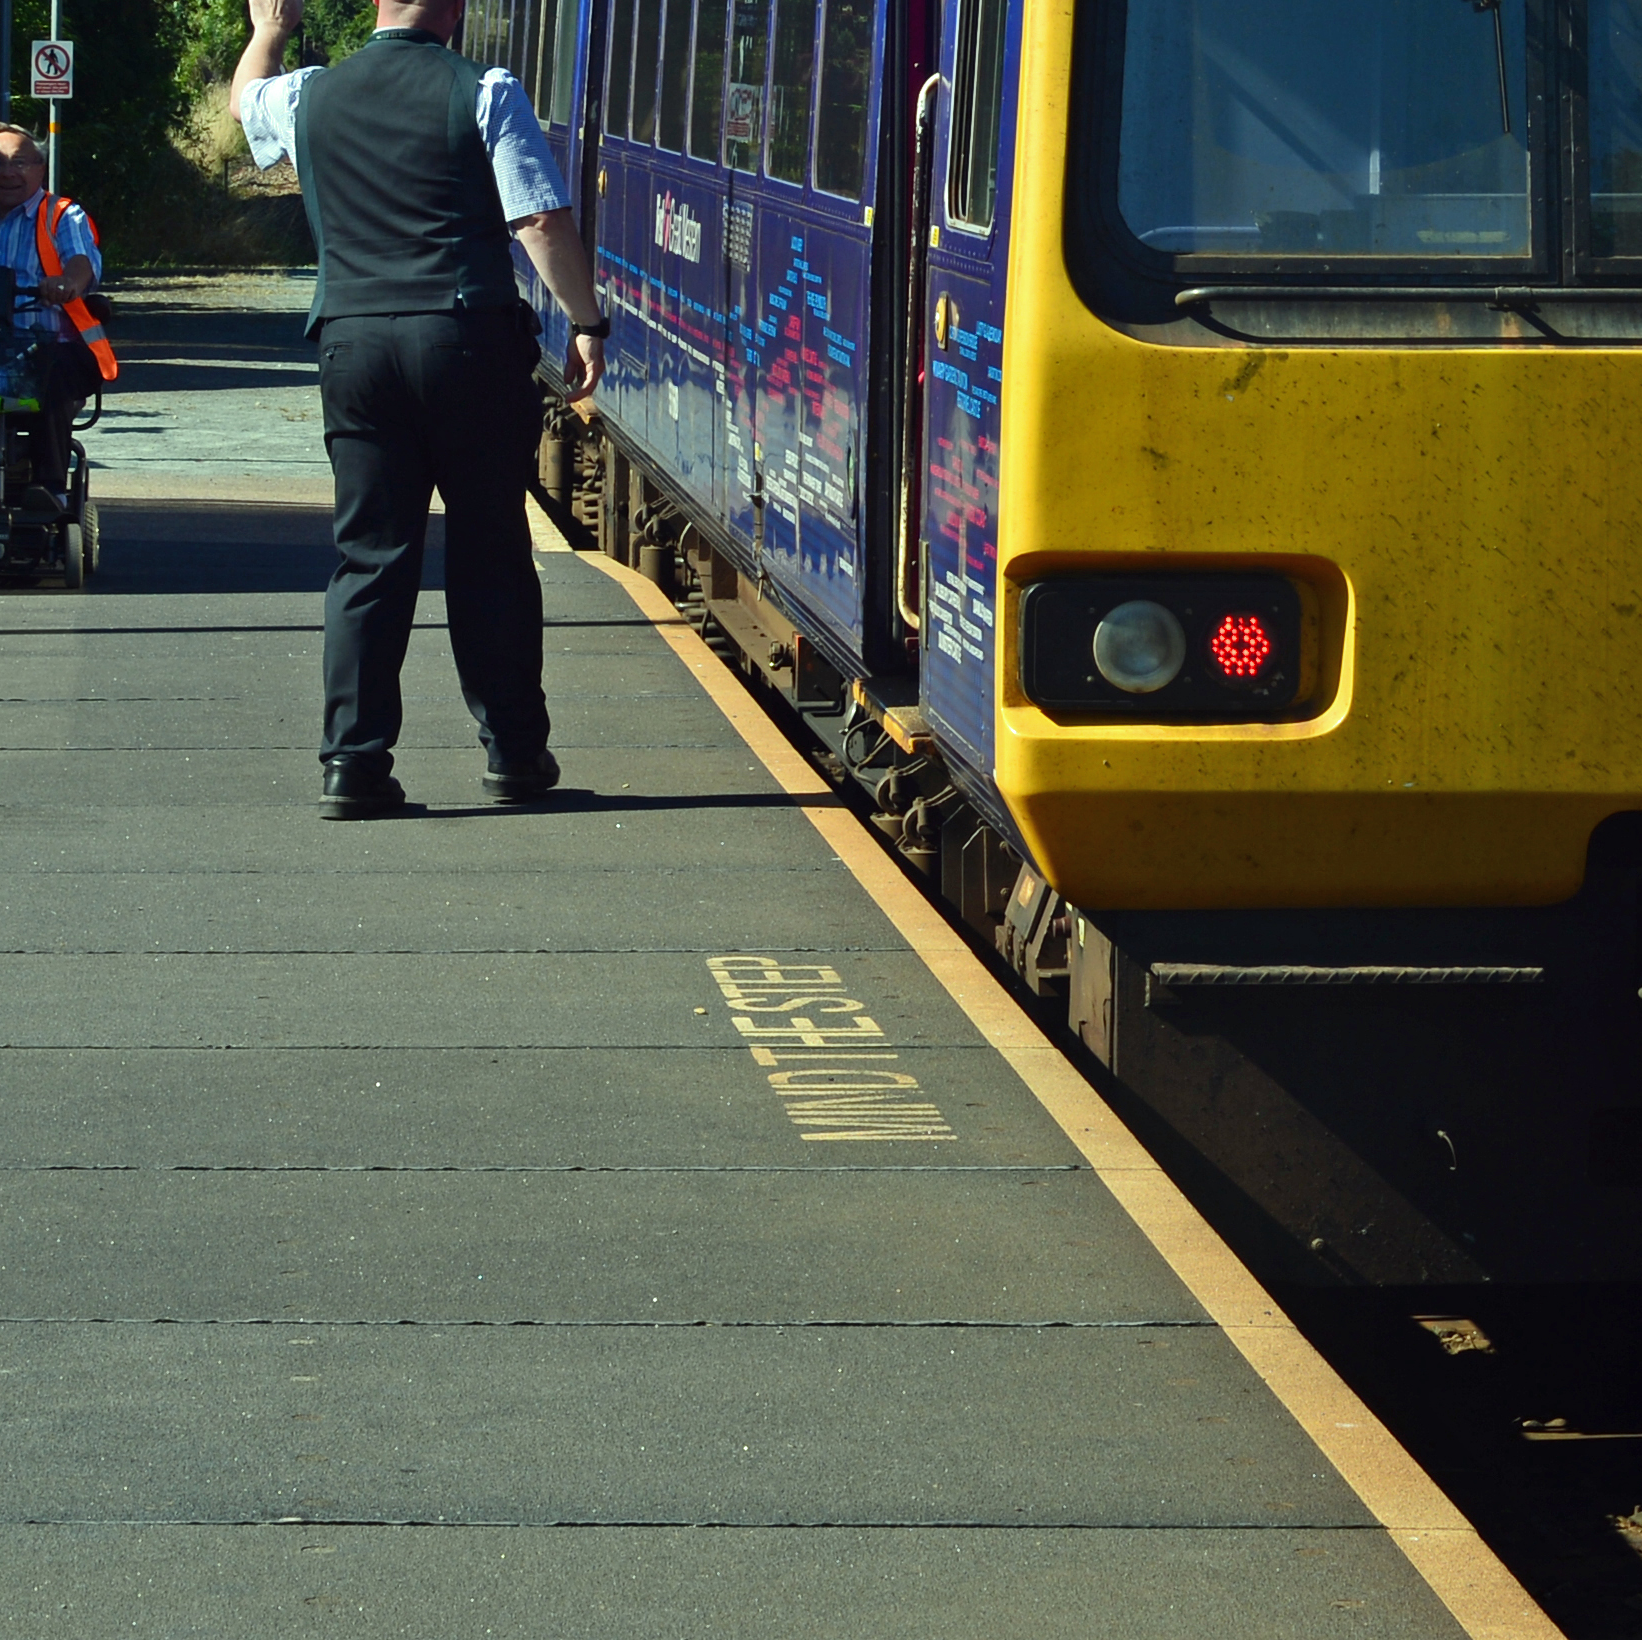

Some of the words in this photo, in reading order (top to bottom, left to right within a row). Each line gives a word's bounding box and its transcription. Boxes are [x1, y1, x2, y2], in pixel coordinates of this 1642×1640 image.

[705, 955, 866, 1014] STEP
[731, 1016, 900, 1067] THE
[767, 1069, 958, 1142] MIND
